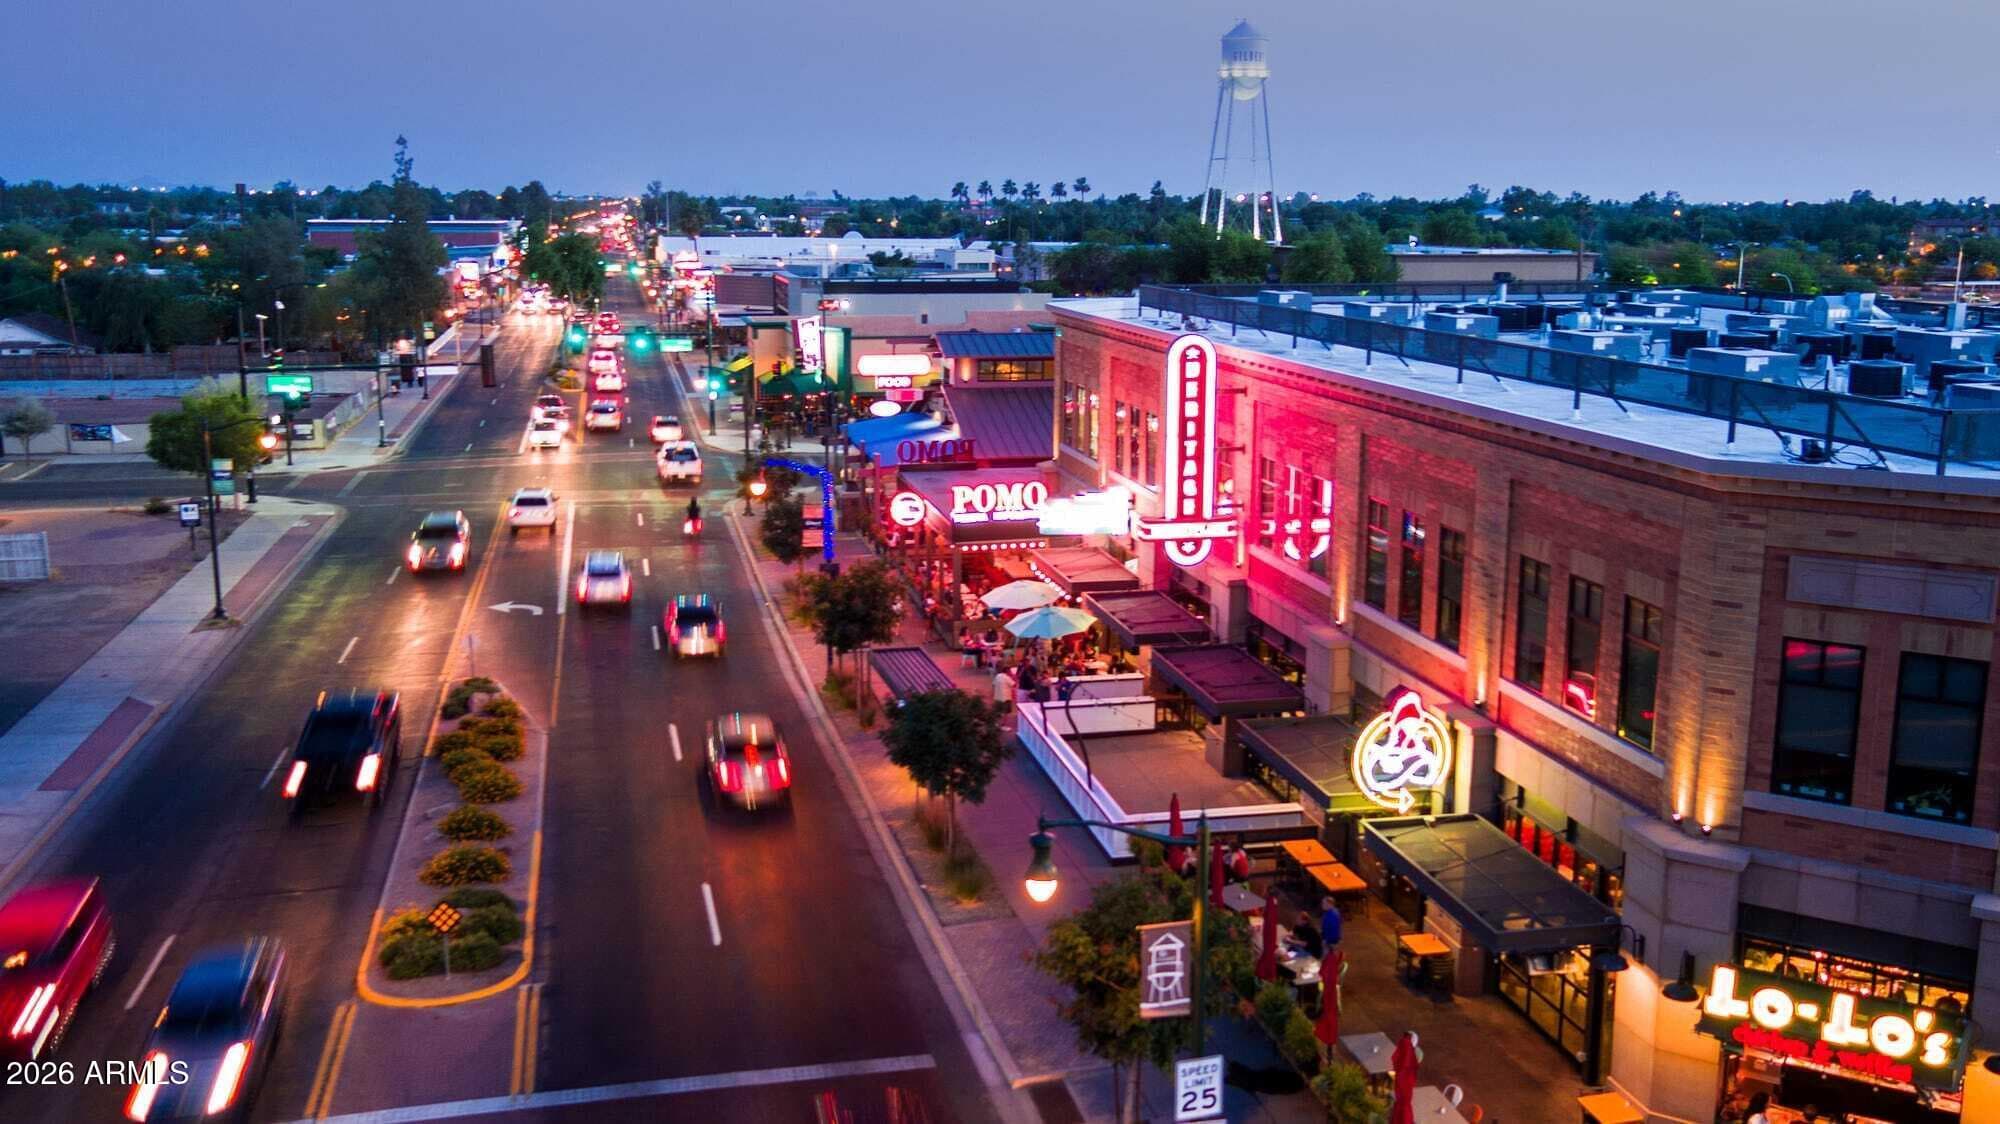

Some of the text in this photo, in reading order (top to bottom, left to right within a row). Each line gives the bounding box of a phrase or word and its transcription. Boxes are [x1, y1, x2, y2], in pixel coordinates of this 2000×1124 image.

[951, 481, 1048, 513] POMO
[1181, 1063, 1218, 1078] SPEED
[1184, 1076, 1213, 1089] LIMIT
[1182, 1087, 1217, 1112] 25
